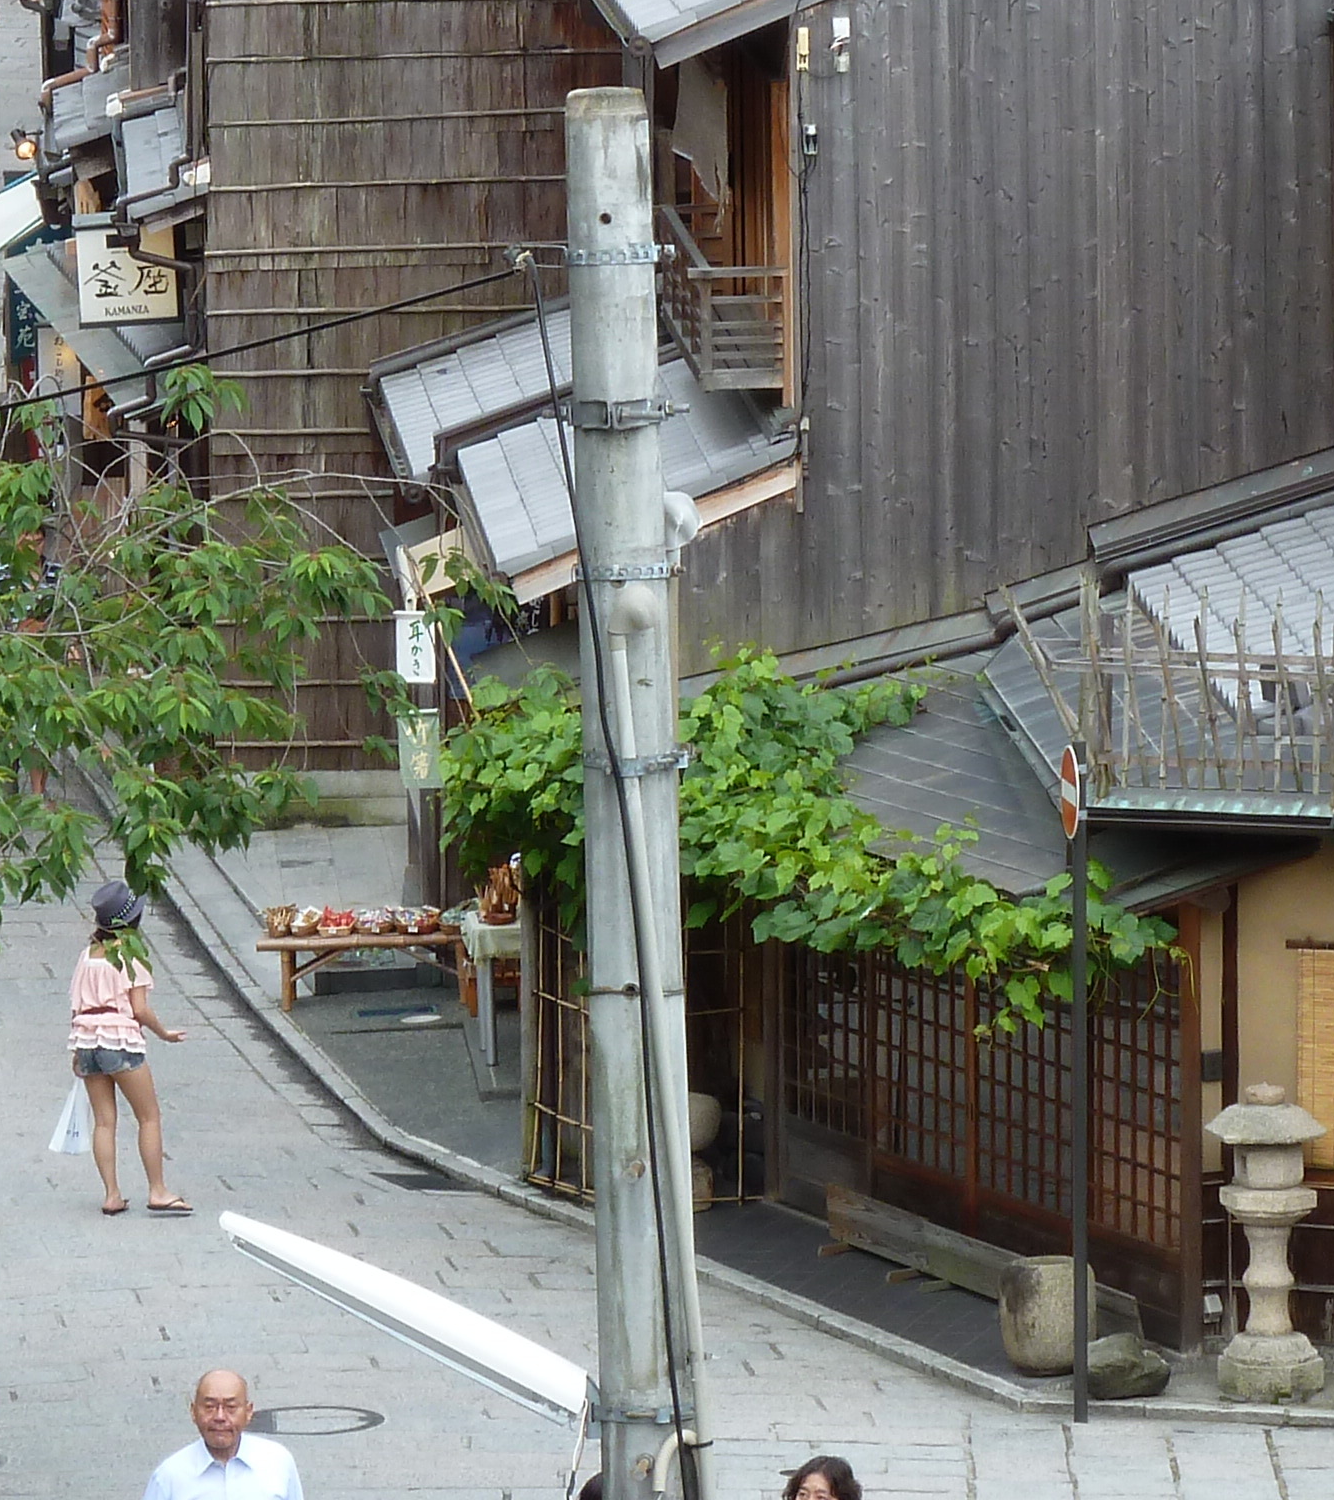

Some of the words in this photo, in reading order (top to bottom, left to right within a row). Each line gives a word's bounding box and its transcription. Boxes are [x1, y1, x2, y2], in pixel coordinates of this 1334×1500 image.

[104, 303, 150, 317] KAMANZA
[408, 619, 424, 677] 耳かき
